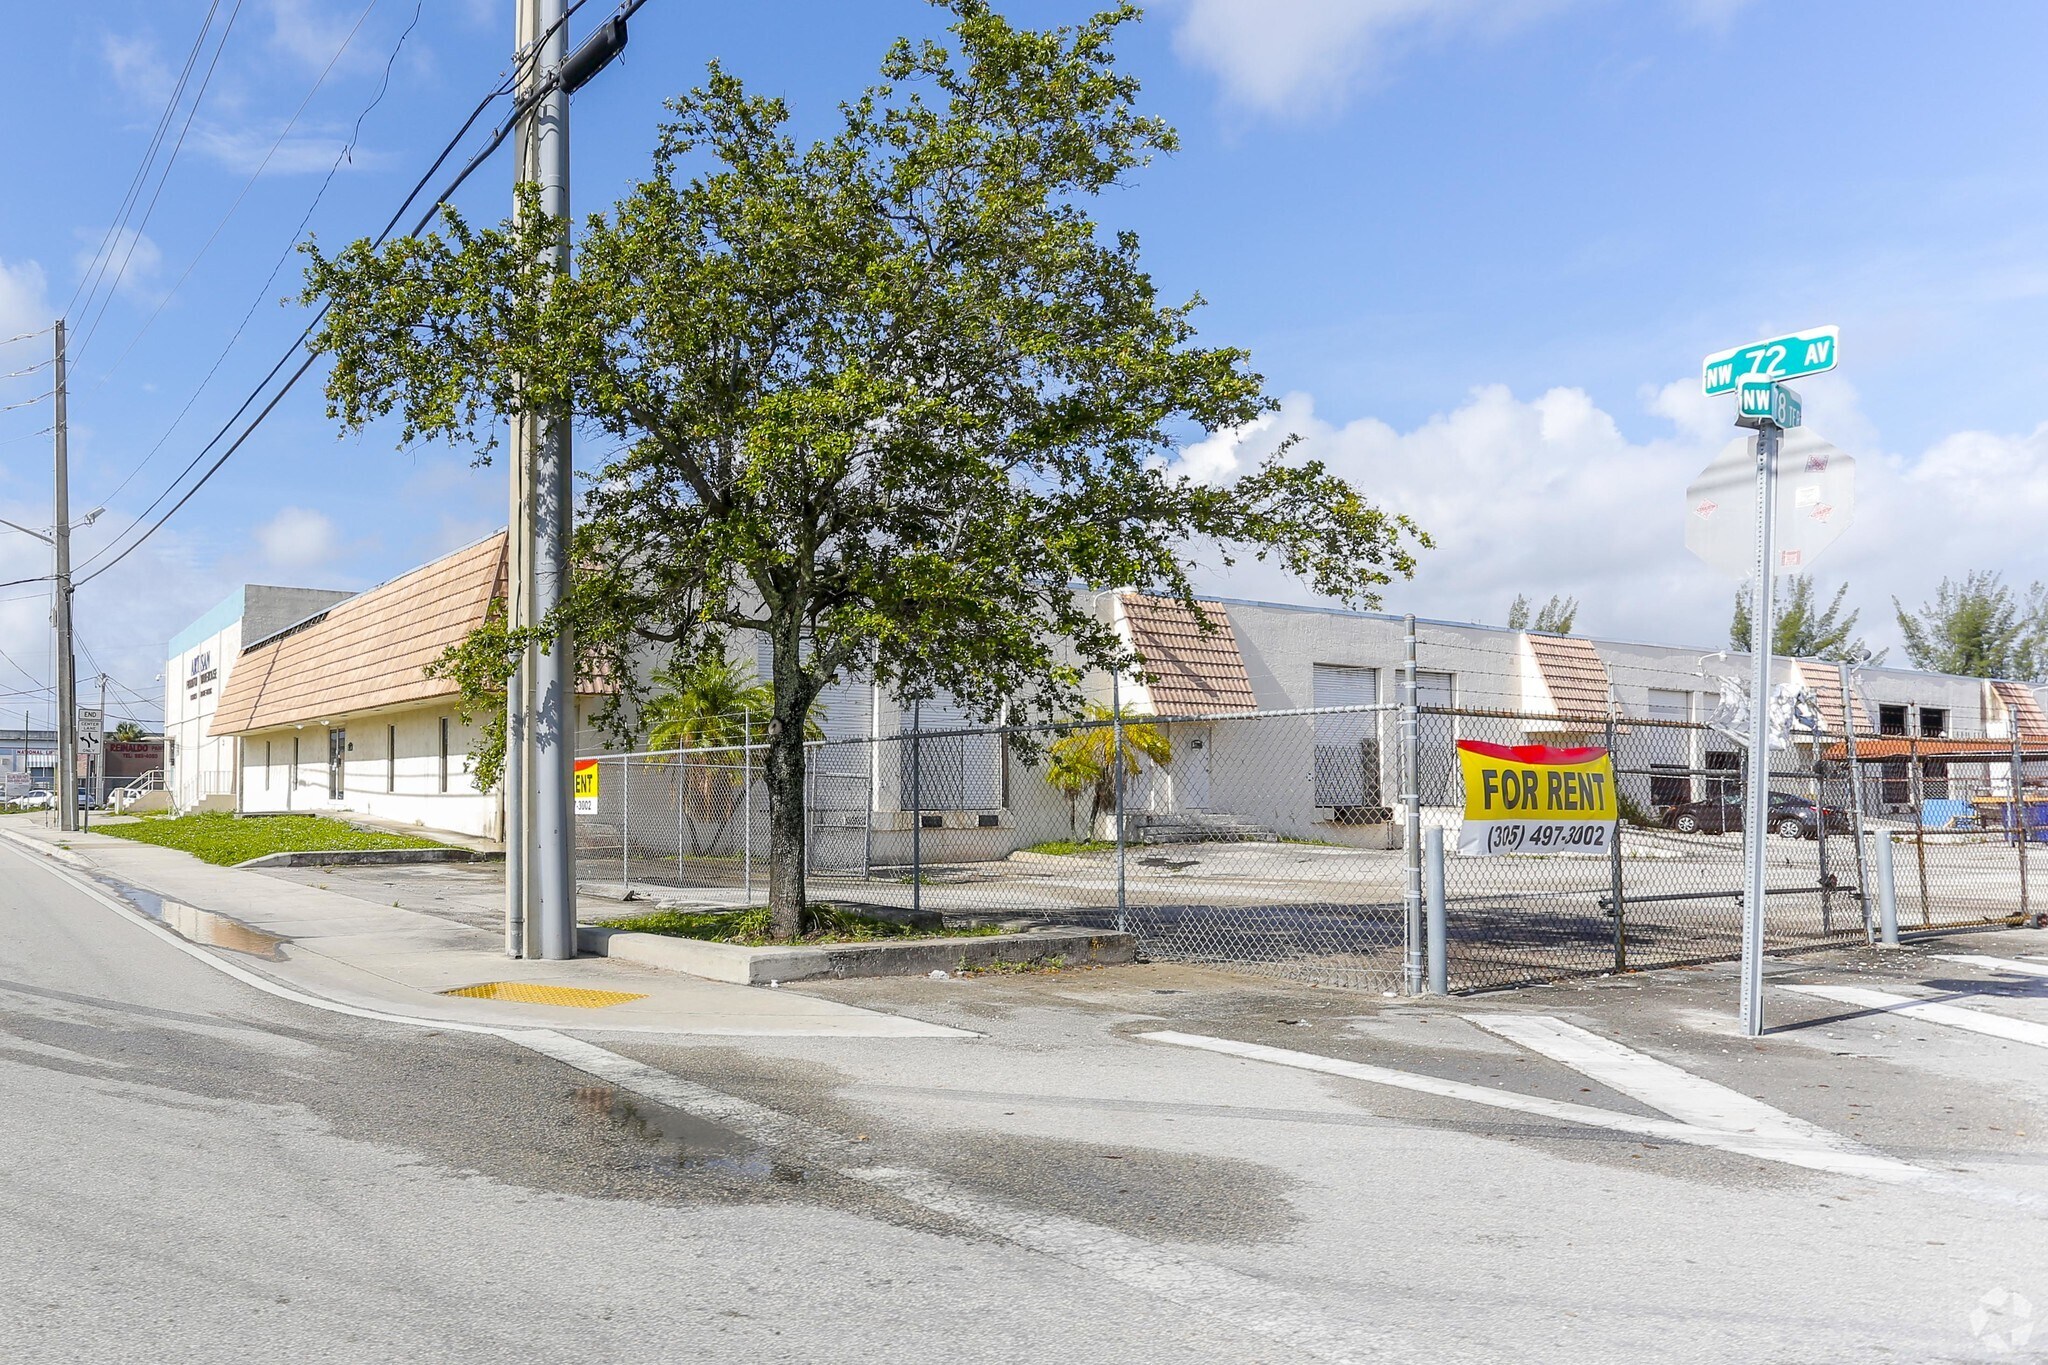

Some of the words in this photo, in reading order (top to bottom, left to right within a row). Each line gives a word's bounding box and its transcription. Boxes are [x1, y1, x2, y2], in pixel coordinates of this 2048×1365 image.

[1706, 363, 1733, 389] NW
[1745, 345, 1787, 375] 72
[1803, 340, 1830, 366] AV
[1743, 389, 1770, 411] NW
[1482, 769, 1538, 810] FOR
[1547, 771, 1604, 811] RENT
[1487, 825, 1525, 853] (305)
[1529, 825, 1605, 846] 497-3002
